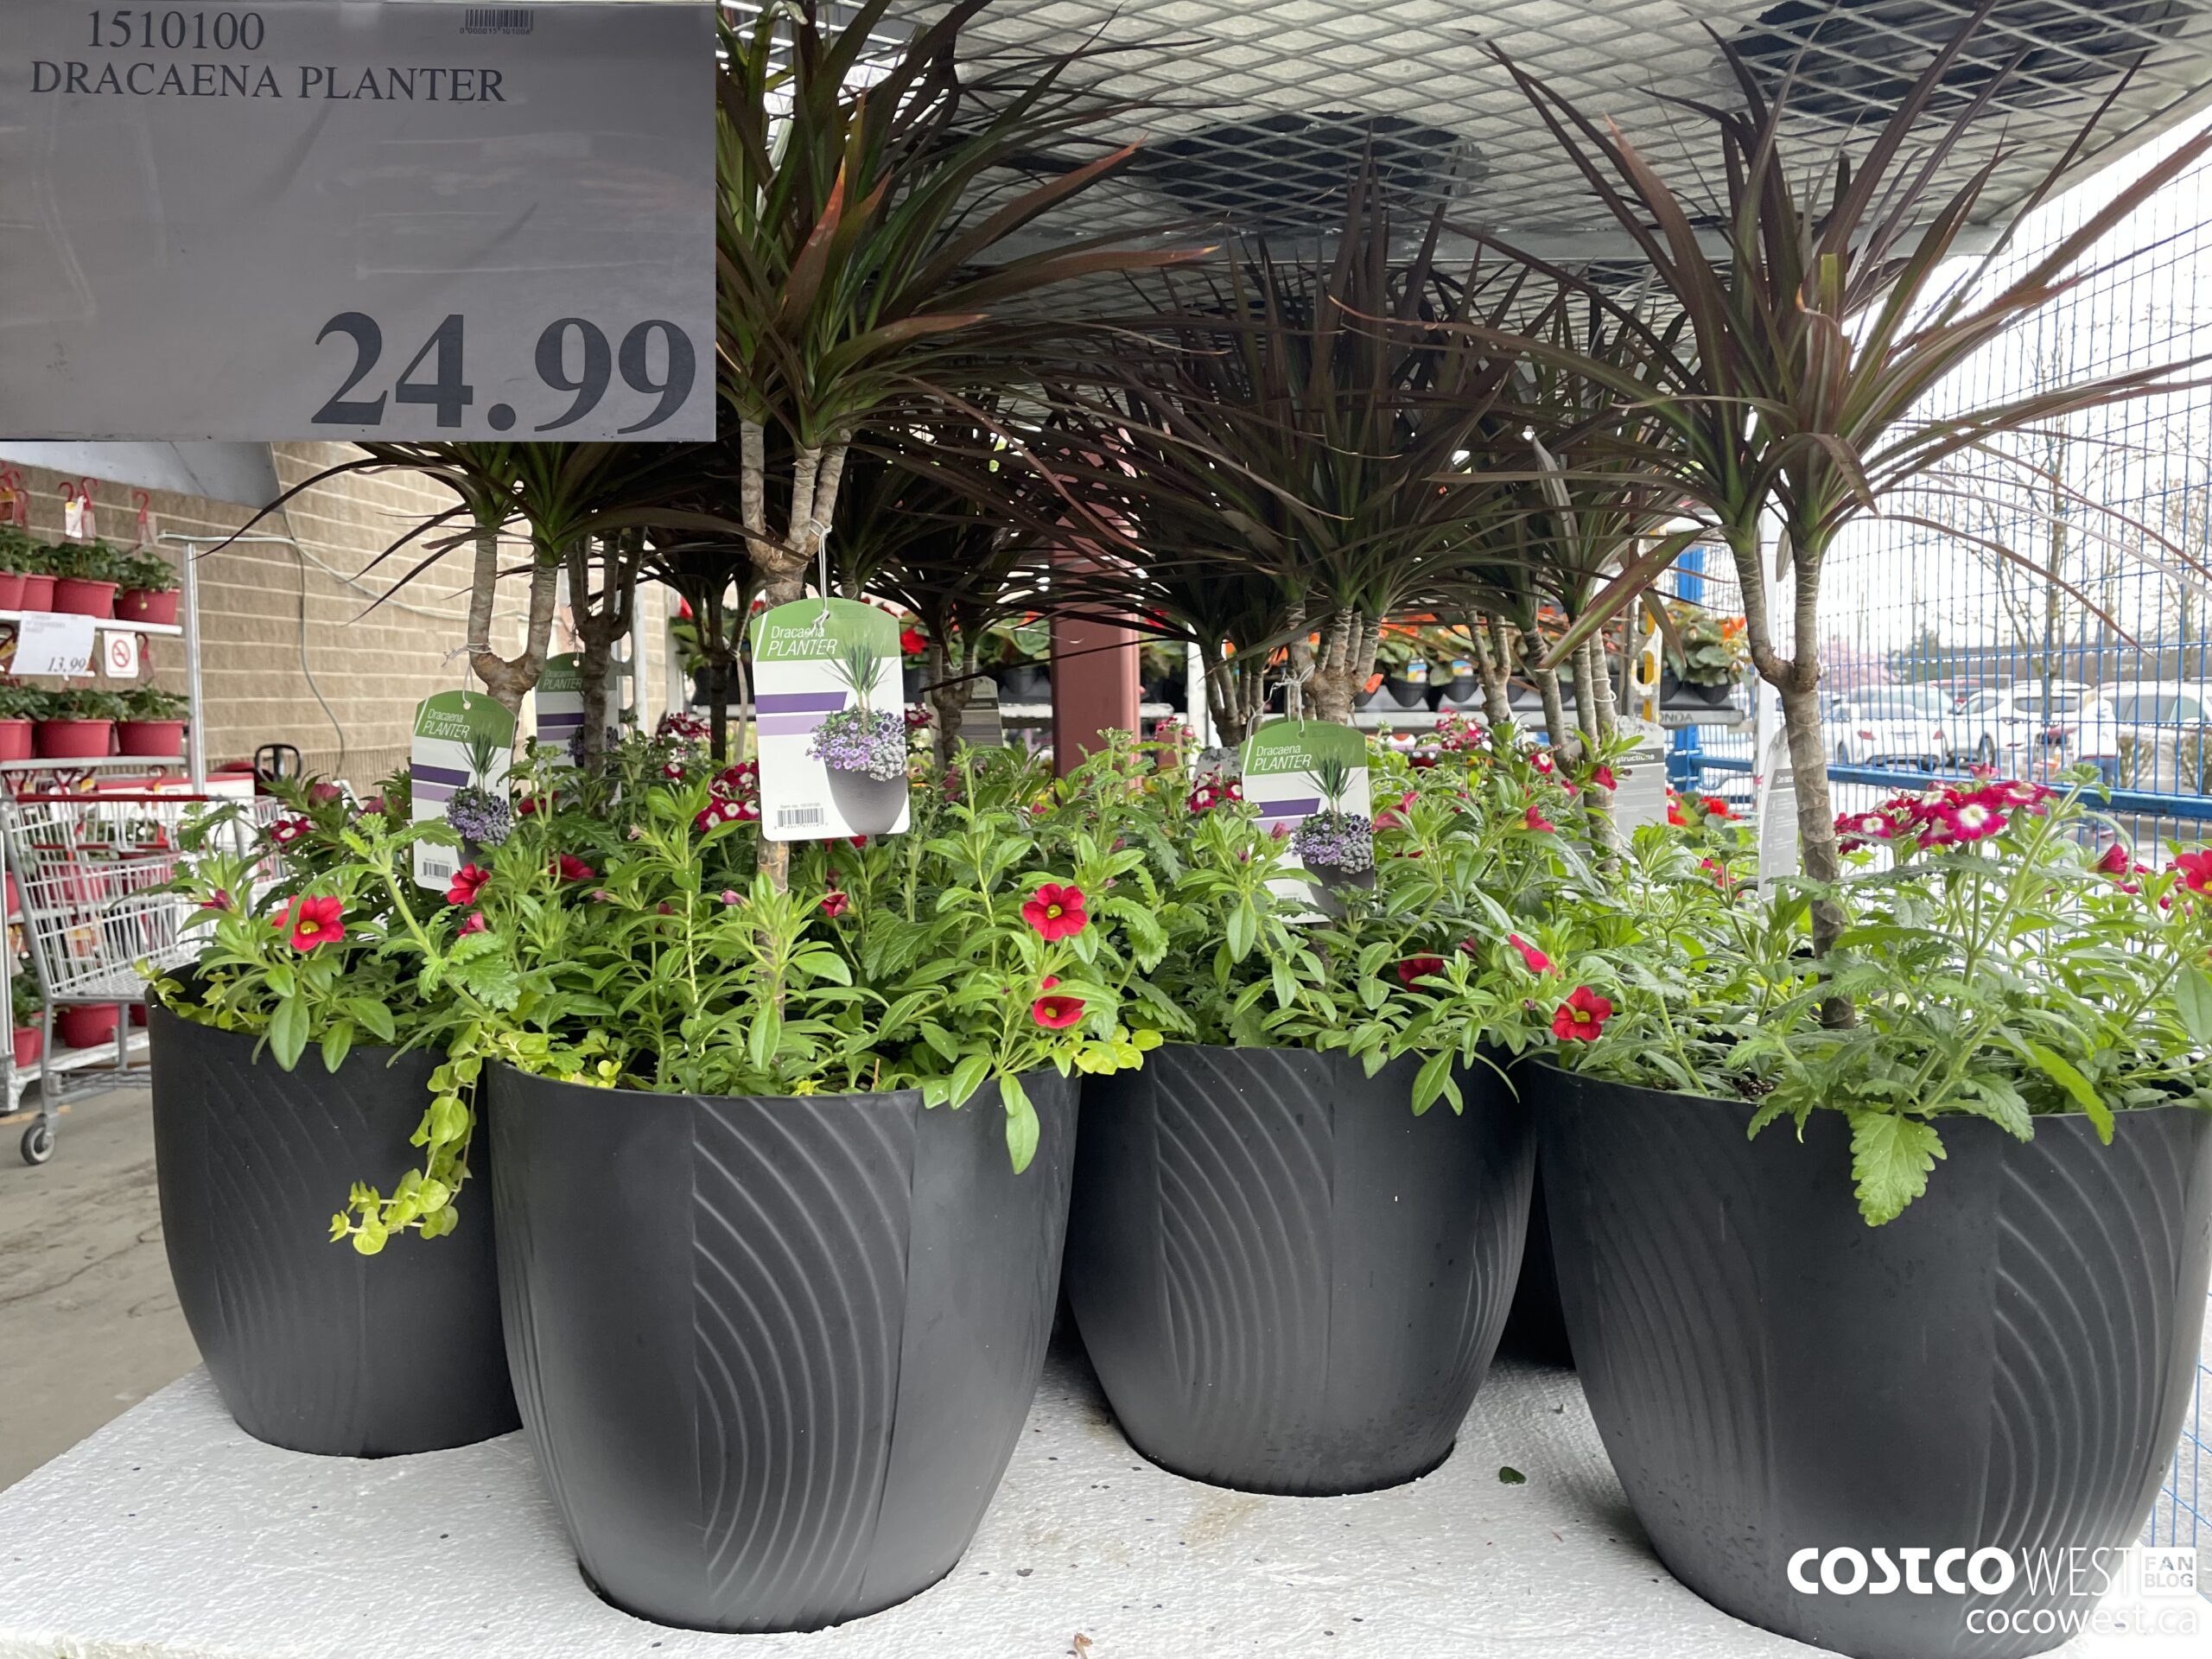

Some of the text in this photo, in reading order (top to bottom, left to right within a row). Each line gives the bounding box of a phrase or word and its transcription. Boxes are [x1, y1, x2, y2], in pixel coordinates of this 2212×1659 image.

[88, 10, 265, 50] 1510100
[30, 60, 507, 103] DRACAENA PLANTER
[311, 310, 696, 435] 24.99
[766, 639, 837, 657] PLANTER
[47, 656, 87, 673] 13.99
[543, 677, 582, 690] PLANTER
[428, 708, 464, 723] Dracaena
[1659, 712, 1694, 723] ONDA
[423, 720, 470, 739] PLANTER
[1256, 745, 1301, 757] Dracaena
[1253, 753, 1312, 772] PLANTER
